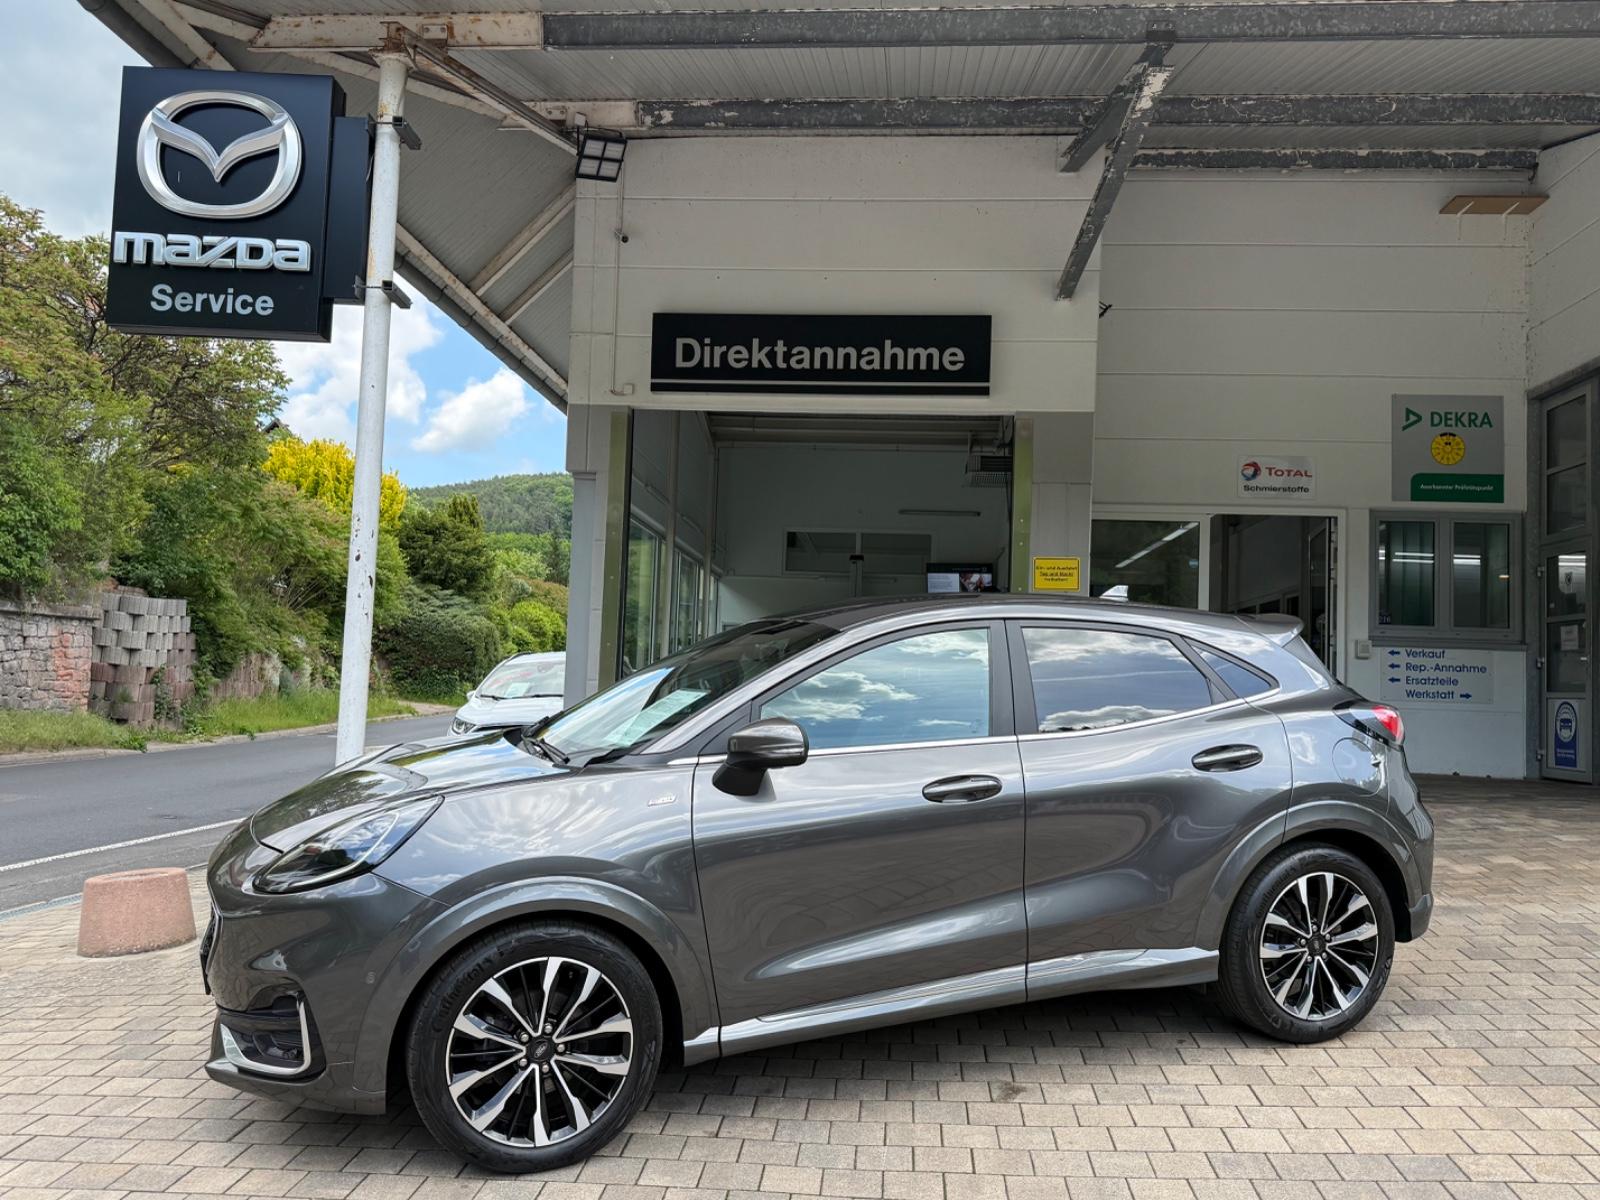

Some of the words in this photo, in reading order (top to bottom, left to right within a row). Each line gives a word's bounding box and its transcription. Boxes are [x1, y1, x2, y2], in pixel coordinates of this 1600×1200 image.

[150, 283, 274, 316] Service
[675, 337, 965, 371] Direktannahme
[1430, 411, 1493, 428] DEKRA
[1265, 466, 1313, 478] TOTAL
[1243, 484, 1310, 494] Schmierstoffe
[1405, 649, 1446, 659] Verkauf
[1405, 662, 1487, 674] Rep.-Annahme
[1405, 676, 1459, 686] Ersatzteile
[1405, 689, 1455, 700] Werkstatt
